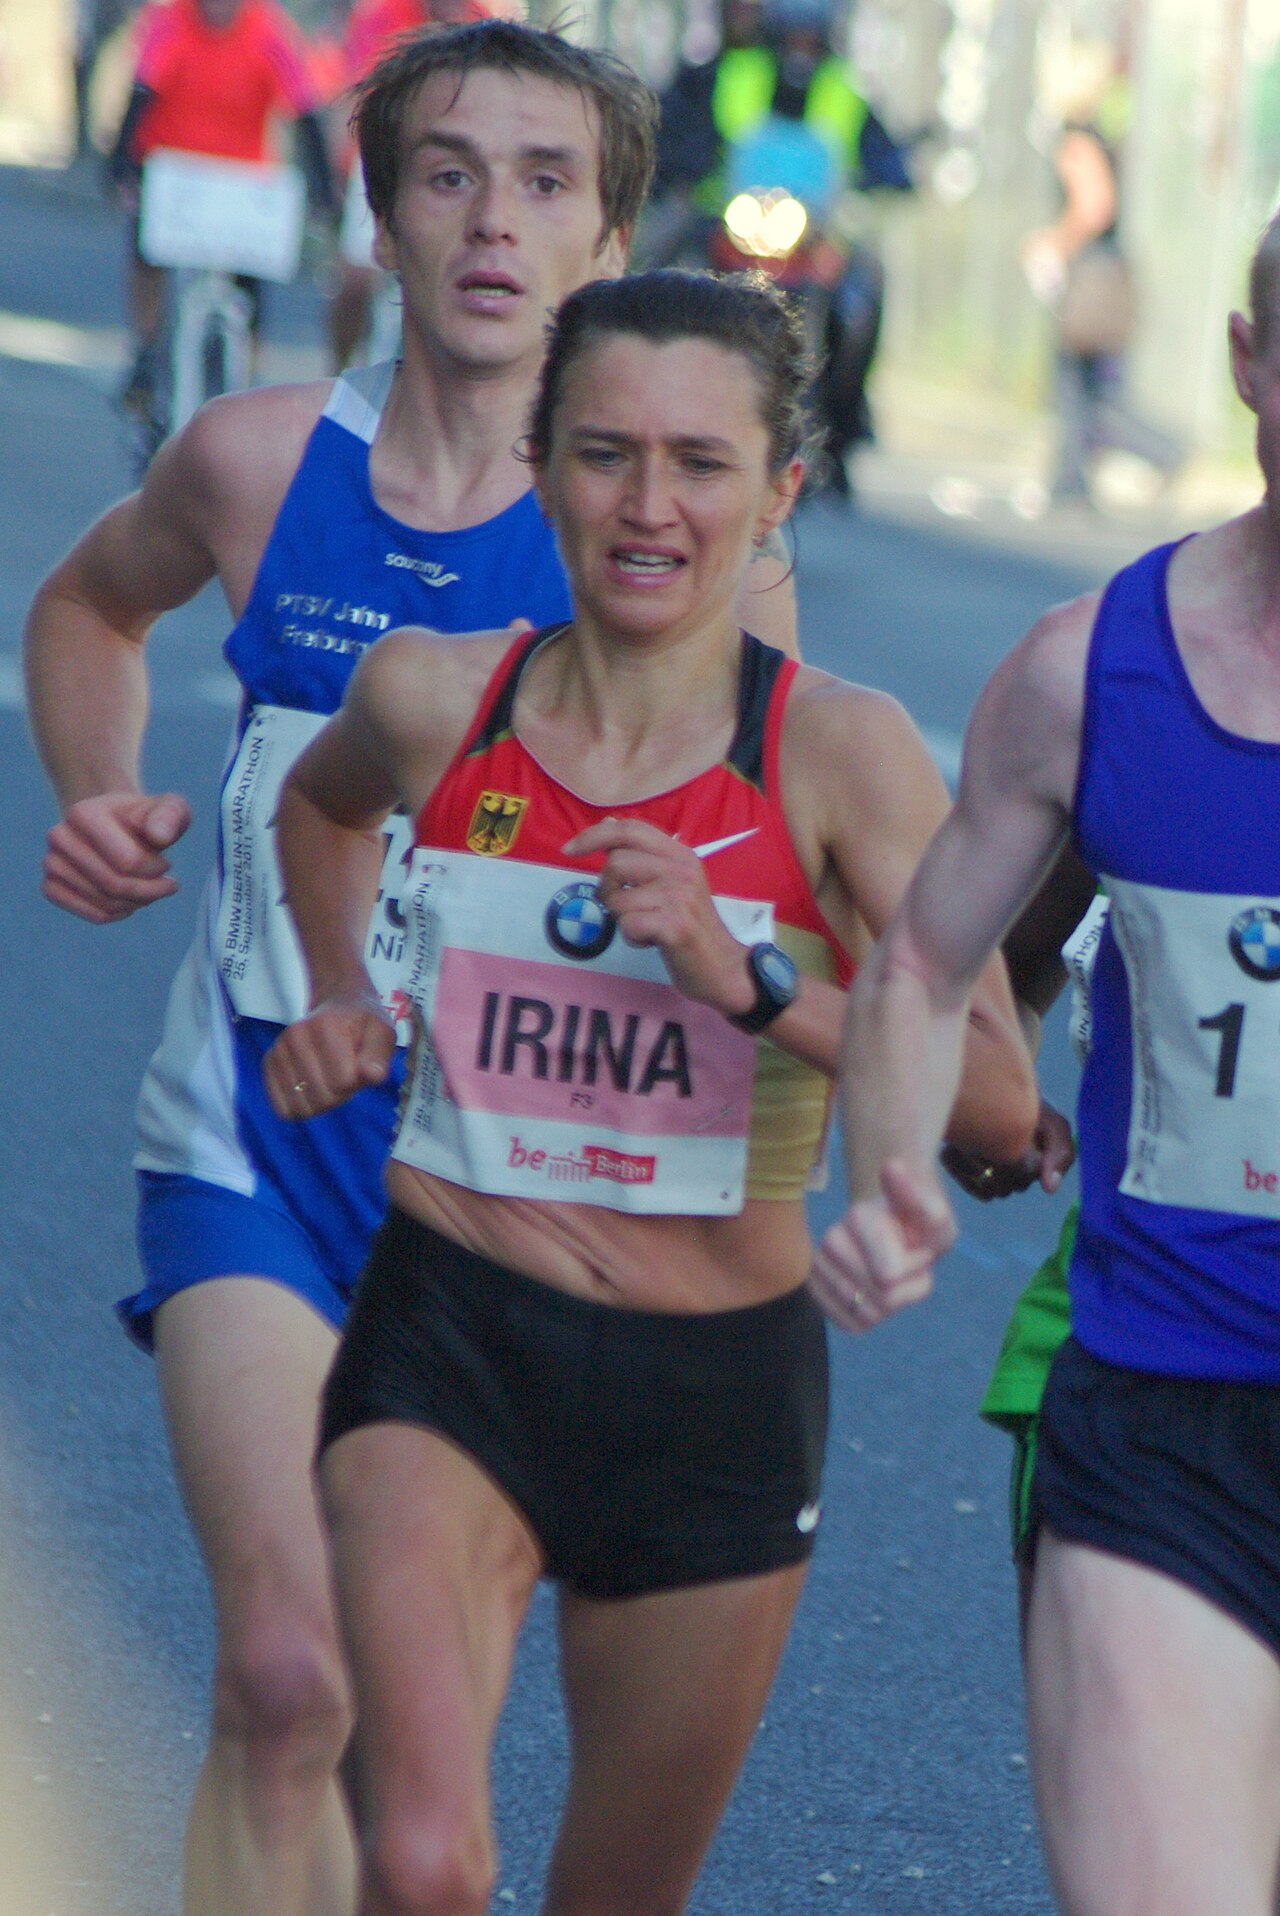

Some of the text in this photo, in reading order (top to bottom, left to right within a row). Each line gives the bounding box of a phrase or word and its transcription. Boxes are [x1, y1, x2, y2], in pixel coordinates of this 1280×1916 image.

[384, 552, 445, 577] saucony
[333, 602, 390, 631] Jahn
[232, 737, 264, 903] BERLIN-MARATHON
[225, 906, 242, 951] BMW
[238, 875, 254, 955] September
[473, 990, 693, 1099] IRINA
[507, 1136, 648, 1181] be Berlin
[1242, 1158, 1278, 1194] be
